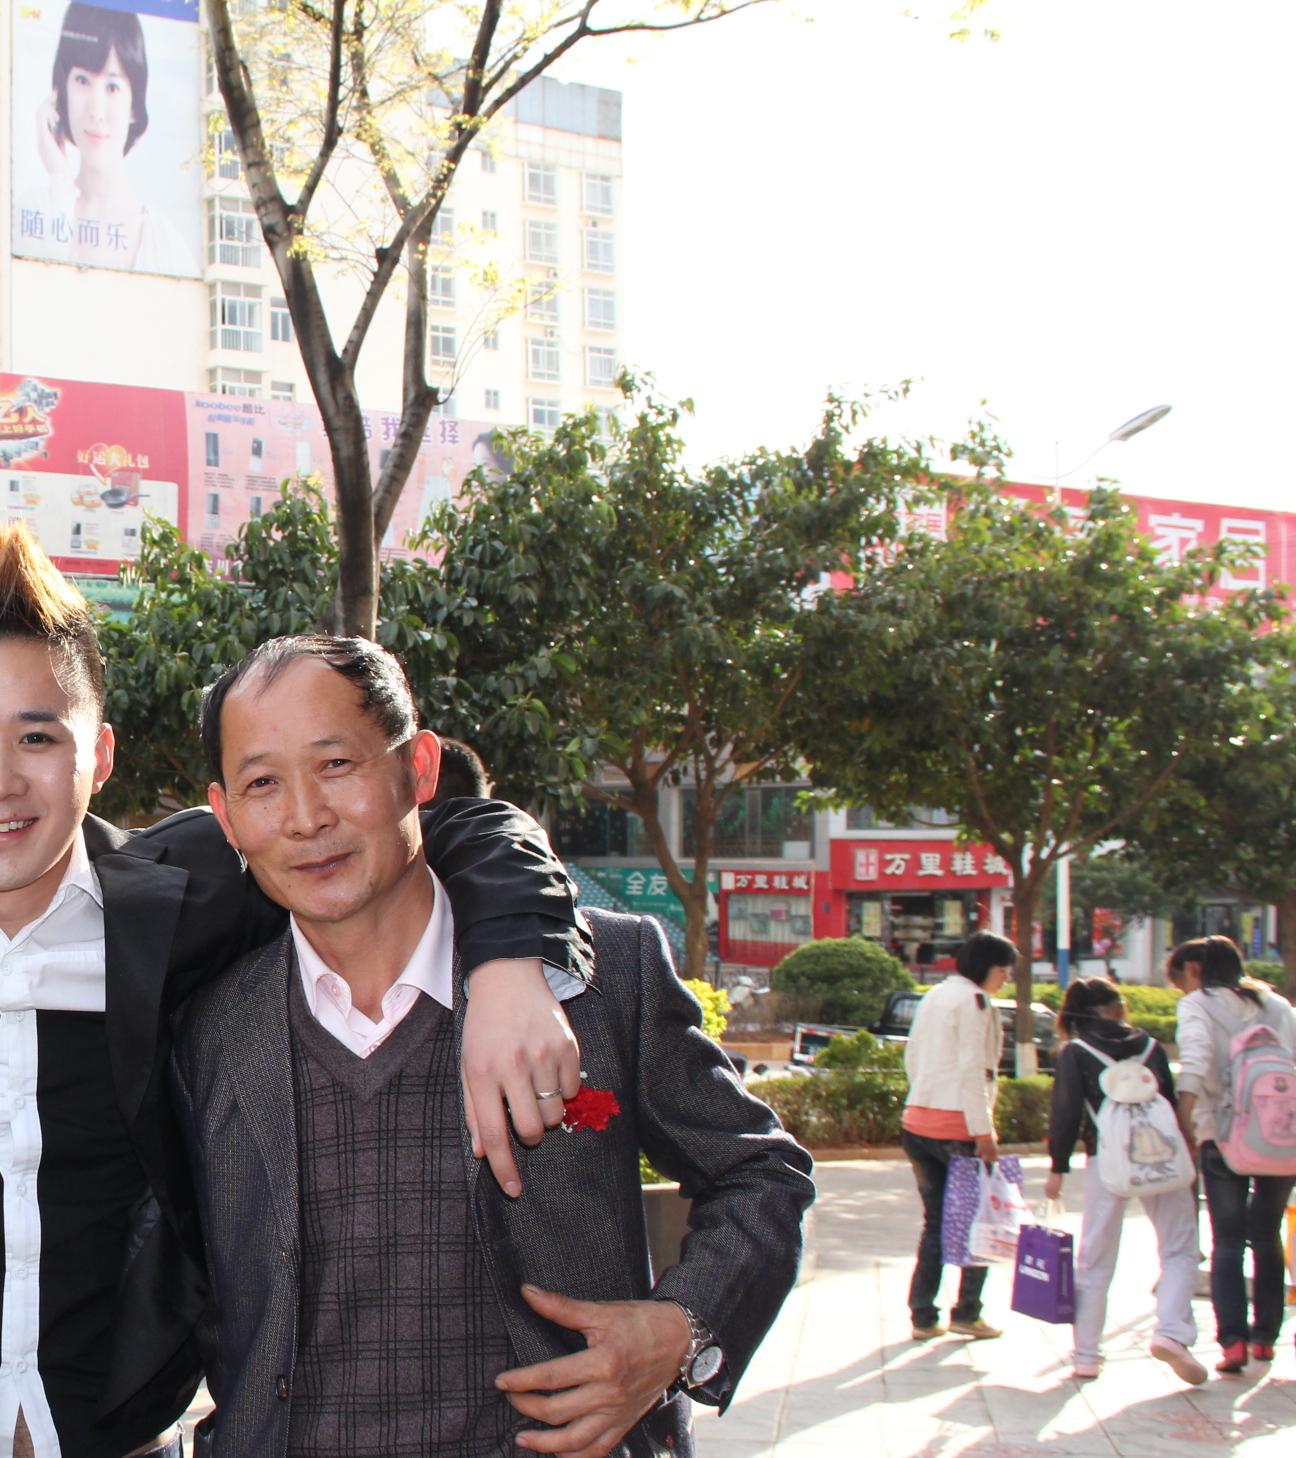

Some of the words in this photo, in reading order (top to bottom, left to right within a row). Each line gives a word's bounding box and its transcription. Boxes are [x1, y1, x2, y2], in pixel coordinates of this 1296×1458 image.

[20, 208, 128, 251] 随心而乐
[884, 851, 1008, 877] 万里鞋城
[625, 871, 668, 897] 全友
[735, 874, 810, 890] 万里鞋城
